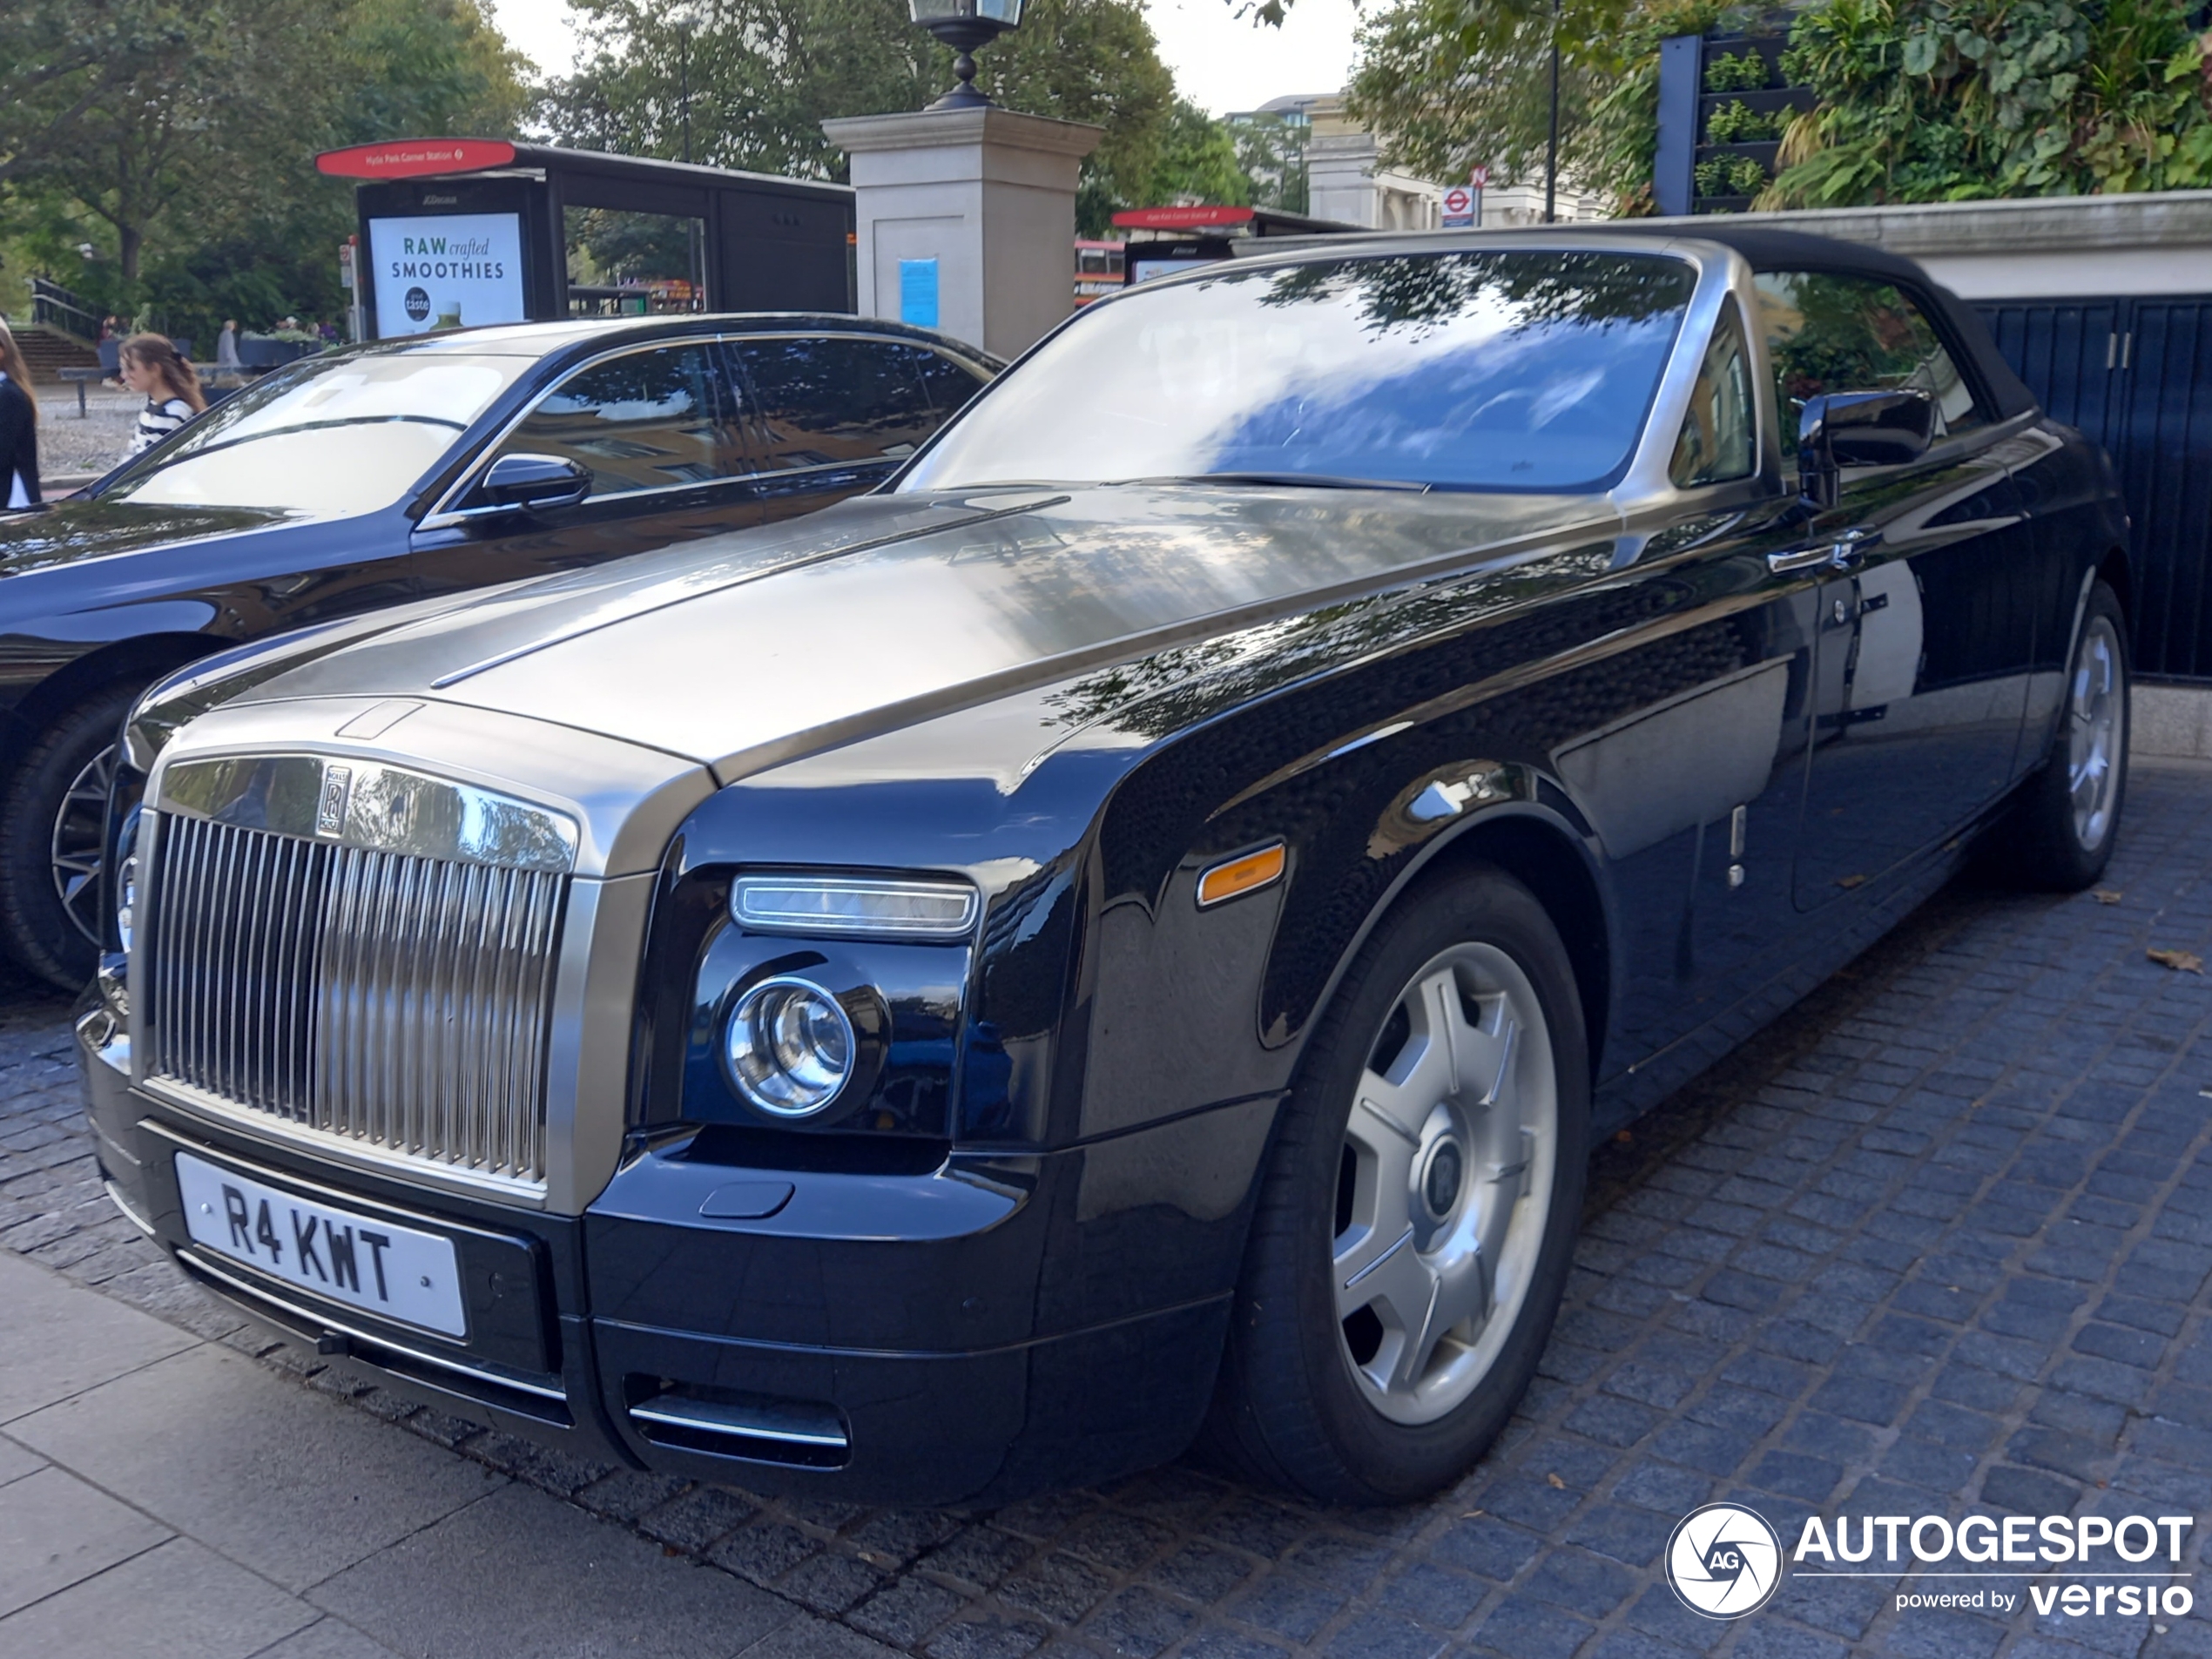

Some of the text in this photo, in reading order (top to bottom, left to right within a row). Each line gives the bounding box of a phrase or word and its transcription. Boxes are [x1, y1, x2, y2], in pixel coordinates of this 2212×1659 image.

[384, 154, 400, 163] Park
[401, 152, 425, 162] Corner
[426, 152, 452, 160] Station
[403, 237, 489, 260] RAW crafted
[392, 262, 503, 279] SMOOTHIES
[406, 300, 429, 311] taste
[221, 1183, 390, 1303] R4 KWT
